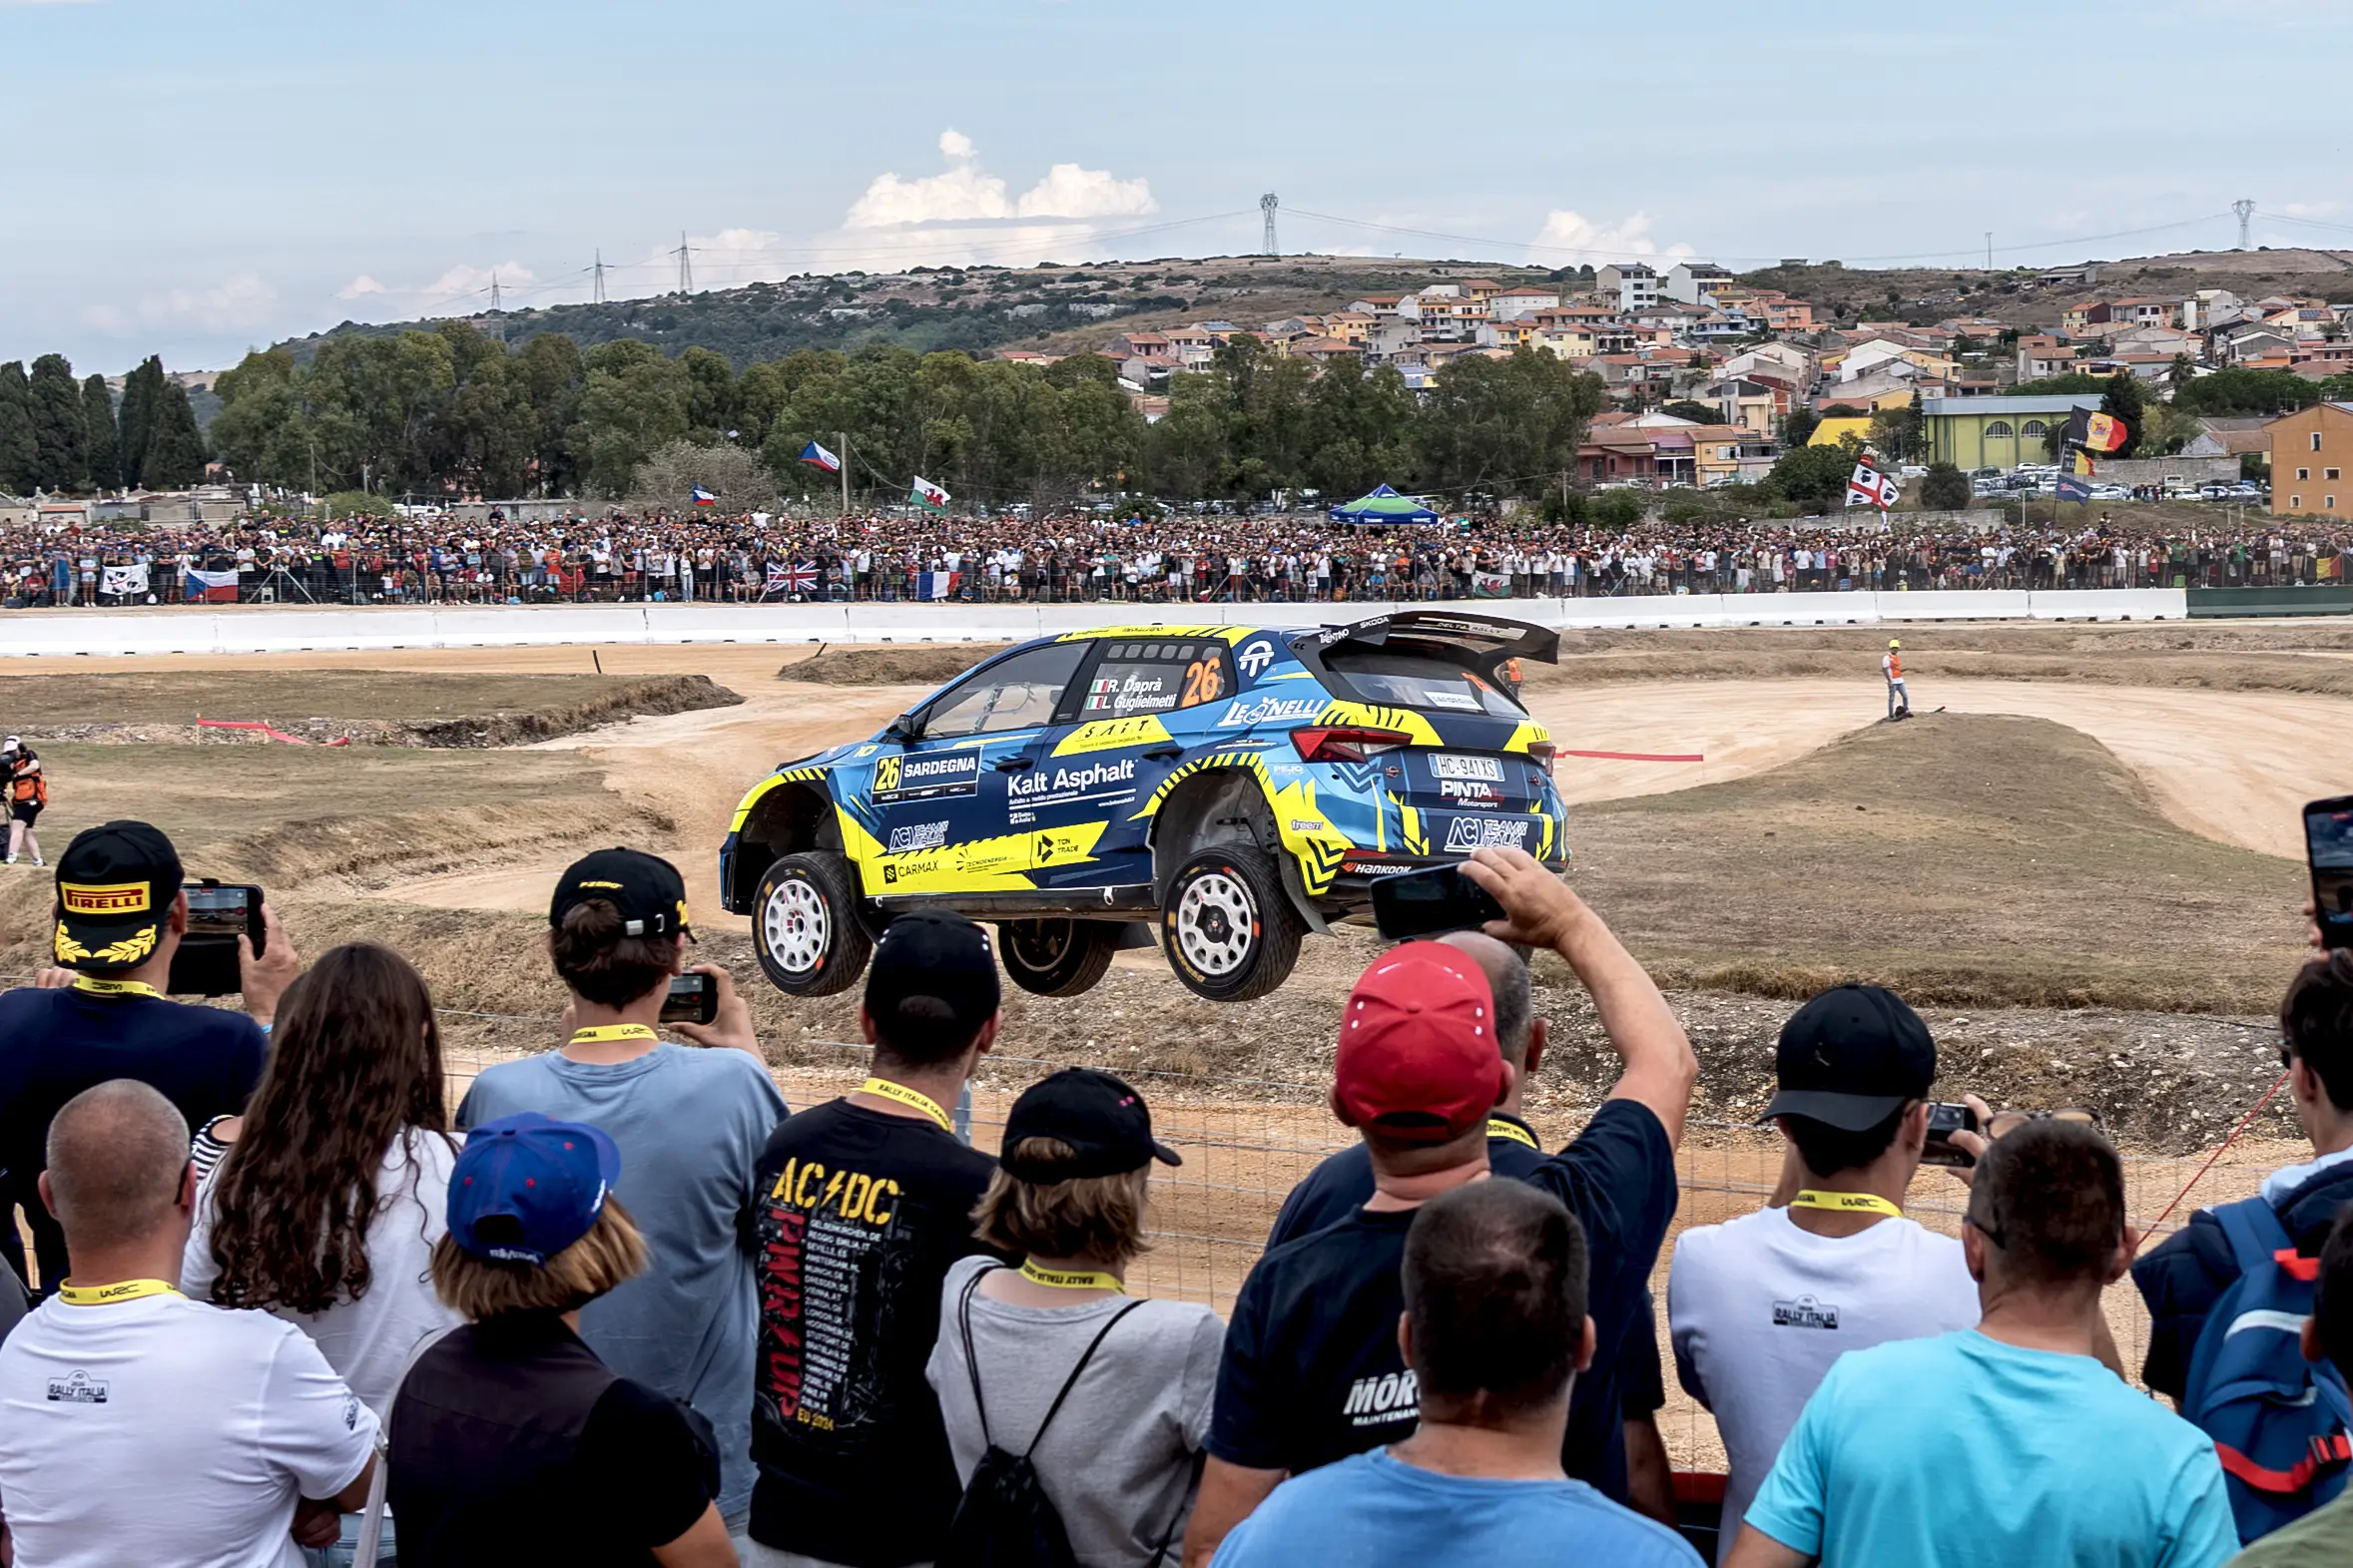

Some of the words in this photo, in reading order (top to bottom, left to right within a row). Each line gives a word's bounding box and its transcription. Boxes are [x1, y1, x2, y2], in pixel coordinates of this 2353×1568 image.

[1107, 680, 1120, 694] R.
[1123, 677, 1162, 696] Daprà
[1181, 657, 1222, 709] 26
[1113, 693, 1177, 712] Guglielmetti
[875, 757, 900, 790] 26
[903, 757, 976, 779] SARDEGNA
[1007, 772, 1048, 796] Kalt
[1053, 759, 1135, 791] Asphalt
[1441, 781, 1492, 798] PINTA
[897, 860, 939, 877] CARMAX
[65, 887, 144, 909] PIRELLI
[879, 1084, 902, 1096] RALLY
[902, 1091, 929, 1108] ITALIA
[771, 1157, 899, 1225] AC/DC
[1065, 1276, 1095, 1285] RALLY
[100, 1285, 140, 1298] WRC
[1775, 1307, 1804, 1321] RALLY
[1806, 1312, 1836, 1324] ITALIA
[49, 1383, 77, 1395] RALLY
[78, 1387, 105, 1396] ITALIA
[1342, 1368, 1421, 1415] MOR
